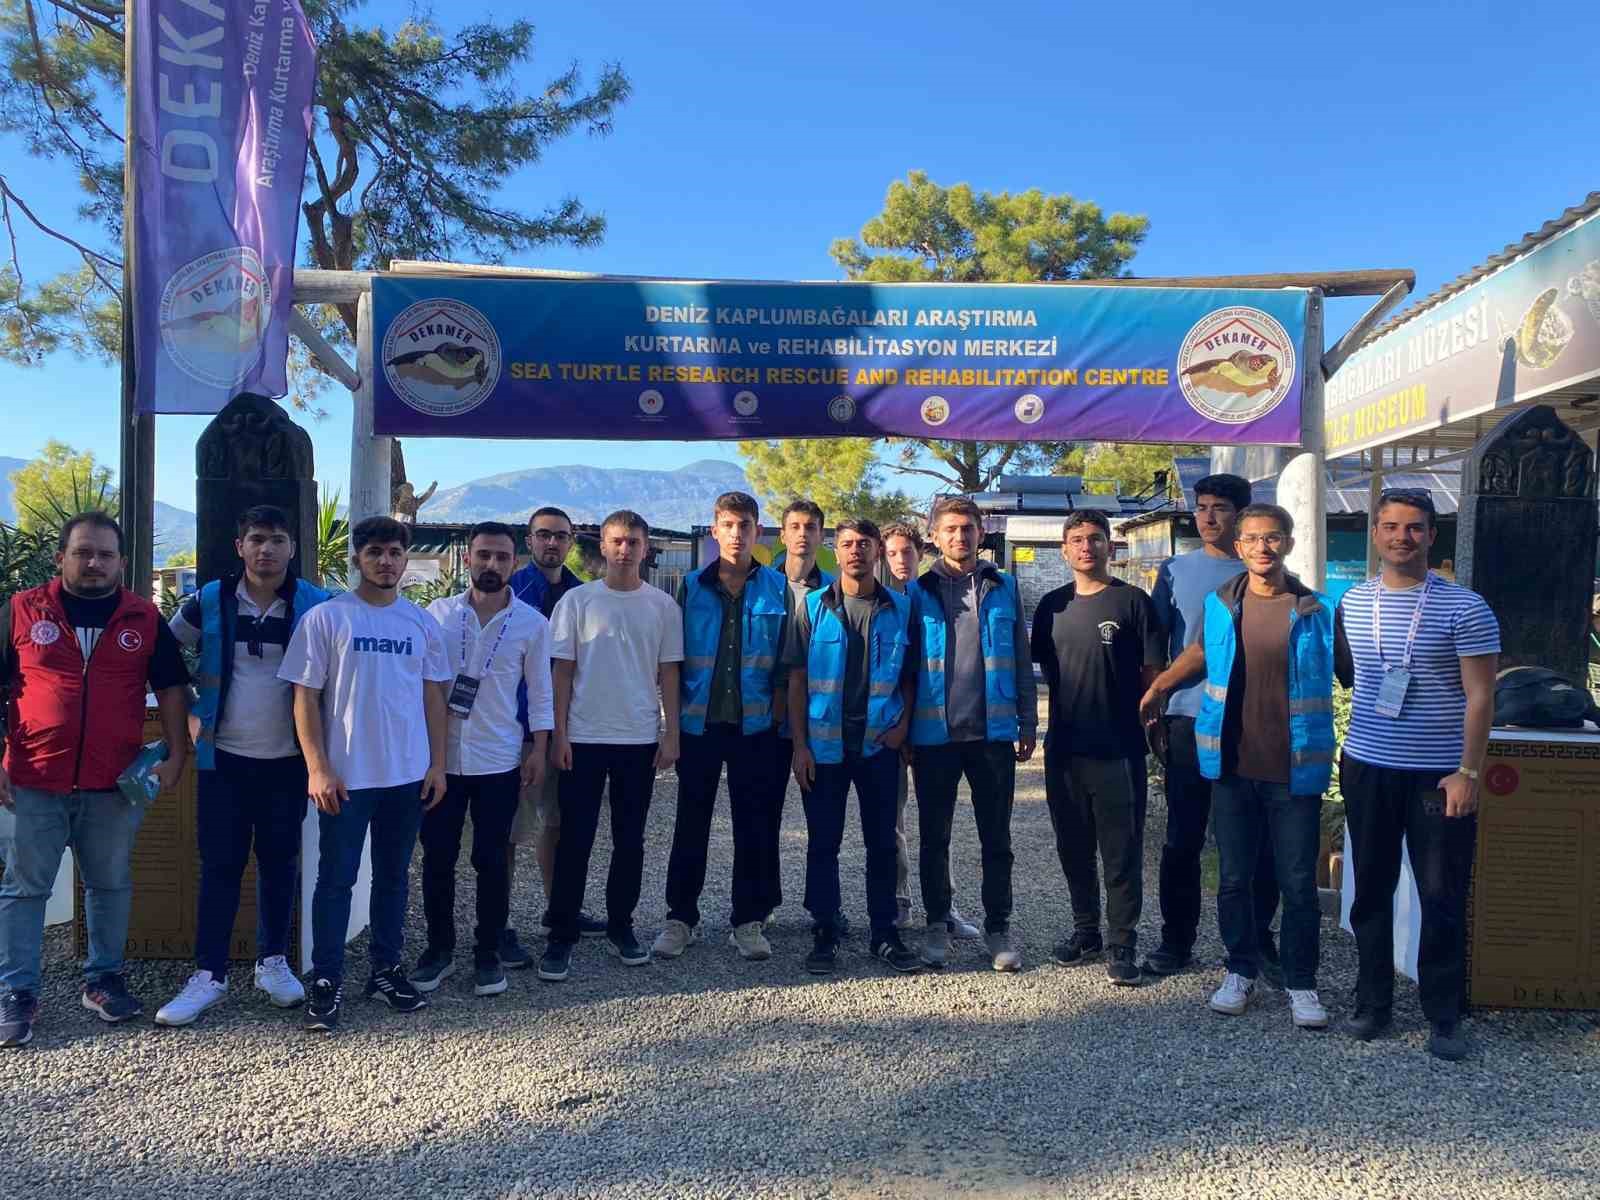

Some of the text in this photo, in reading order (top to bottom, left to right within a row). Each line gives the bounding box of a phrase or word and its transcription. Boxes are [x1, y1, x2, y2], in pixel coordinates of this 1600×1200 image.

[243, 32, 264, 76] Deniz
[269, 17, 294, 103] Kurtarma
[256, 107, 284, 188] Araştırma
[646, 303, 1037, 330] DENİZ KAPLUMBAĞALARI ARAŞTIRMA
[409, 323, 473, 344] DEKAMER
[1205, 332, 1268, 352] DEKAMER
[1408, 293, 1489, 374] MÜZESİ
[625, 335, 1057, 356] KURTARMA ve REHABİLİTASYON MERKEZİ
[511, 363, 1169, 386] SEA TURTLE RESEARCH RESCUE AND REHABILITATION CENTRE
[1354, 383, 1428, 440] MUSEUM
[353, 636, 412, 655] mavi
[126, 939, 250, 954] DEKAR
[1513, 984, 1600, 1004] DEKA
